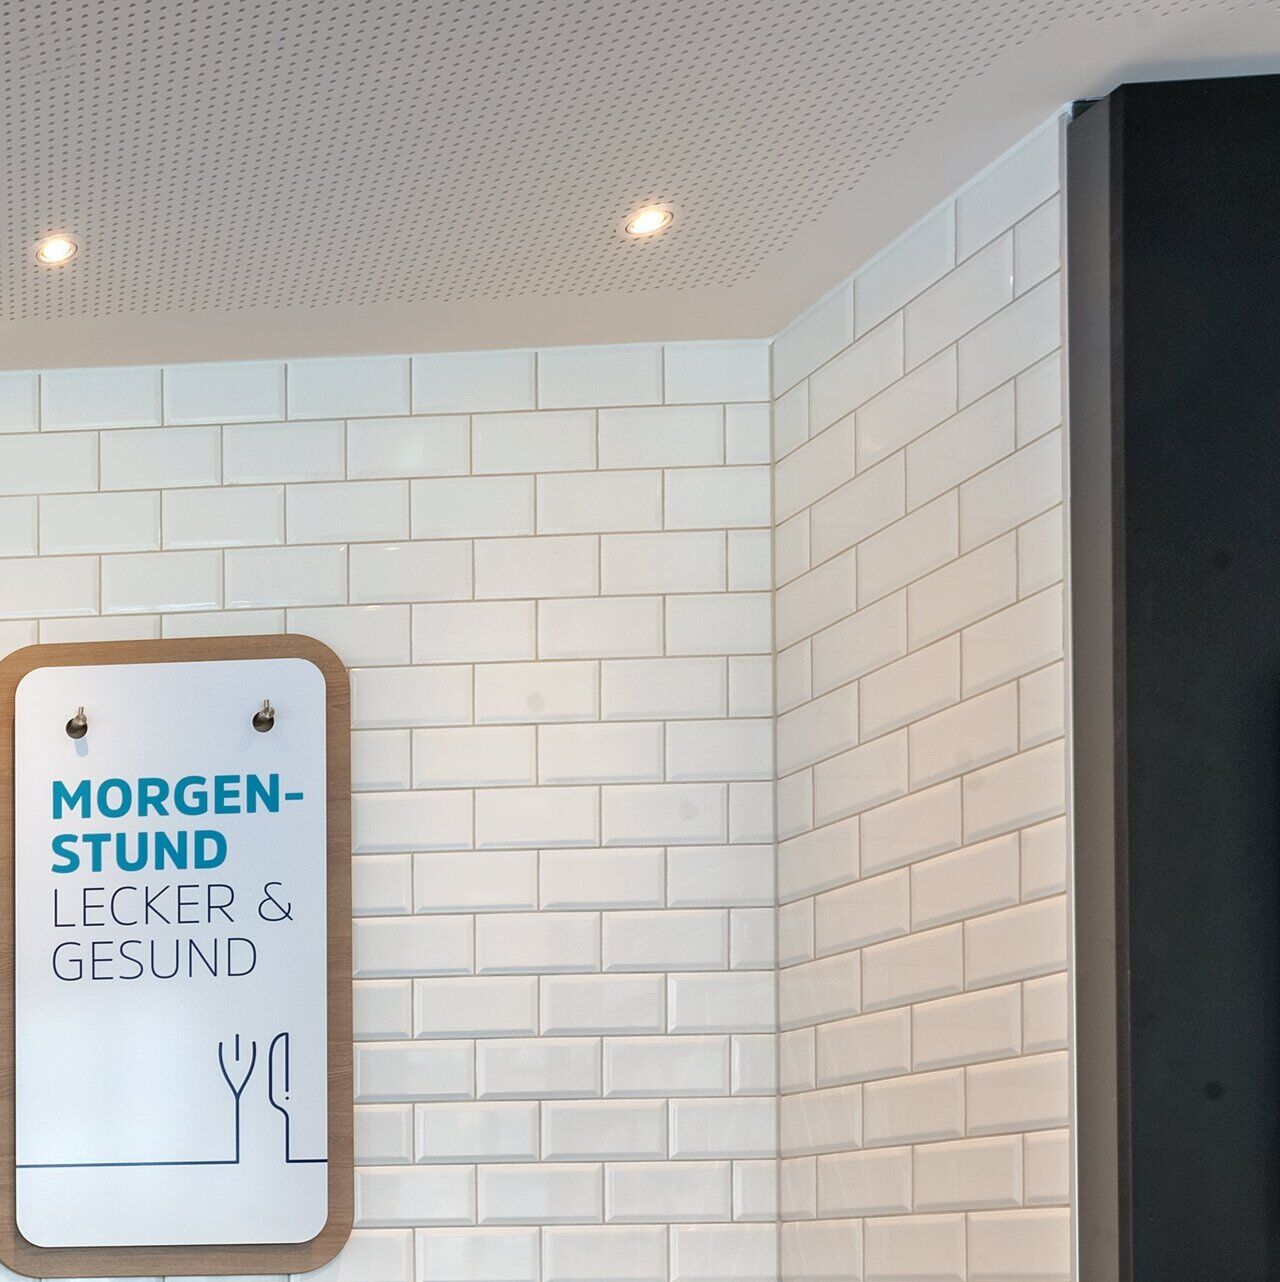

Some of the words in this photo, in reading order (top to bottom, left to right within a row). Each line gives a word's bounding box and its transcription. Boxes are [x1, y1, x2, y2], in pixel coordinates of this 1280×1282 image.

[52, 773, 304, 820] MORGEN-
[51, 830, 227, 874] STUND
[54, 883, 235, 928] LECKER
[258, 881, 294, 922] &
[52, 937, 257, 981] GESUND
